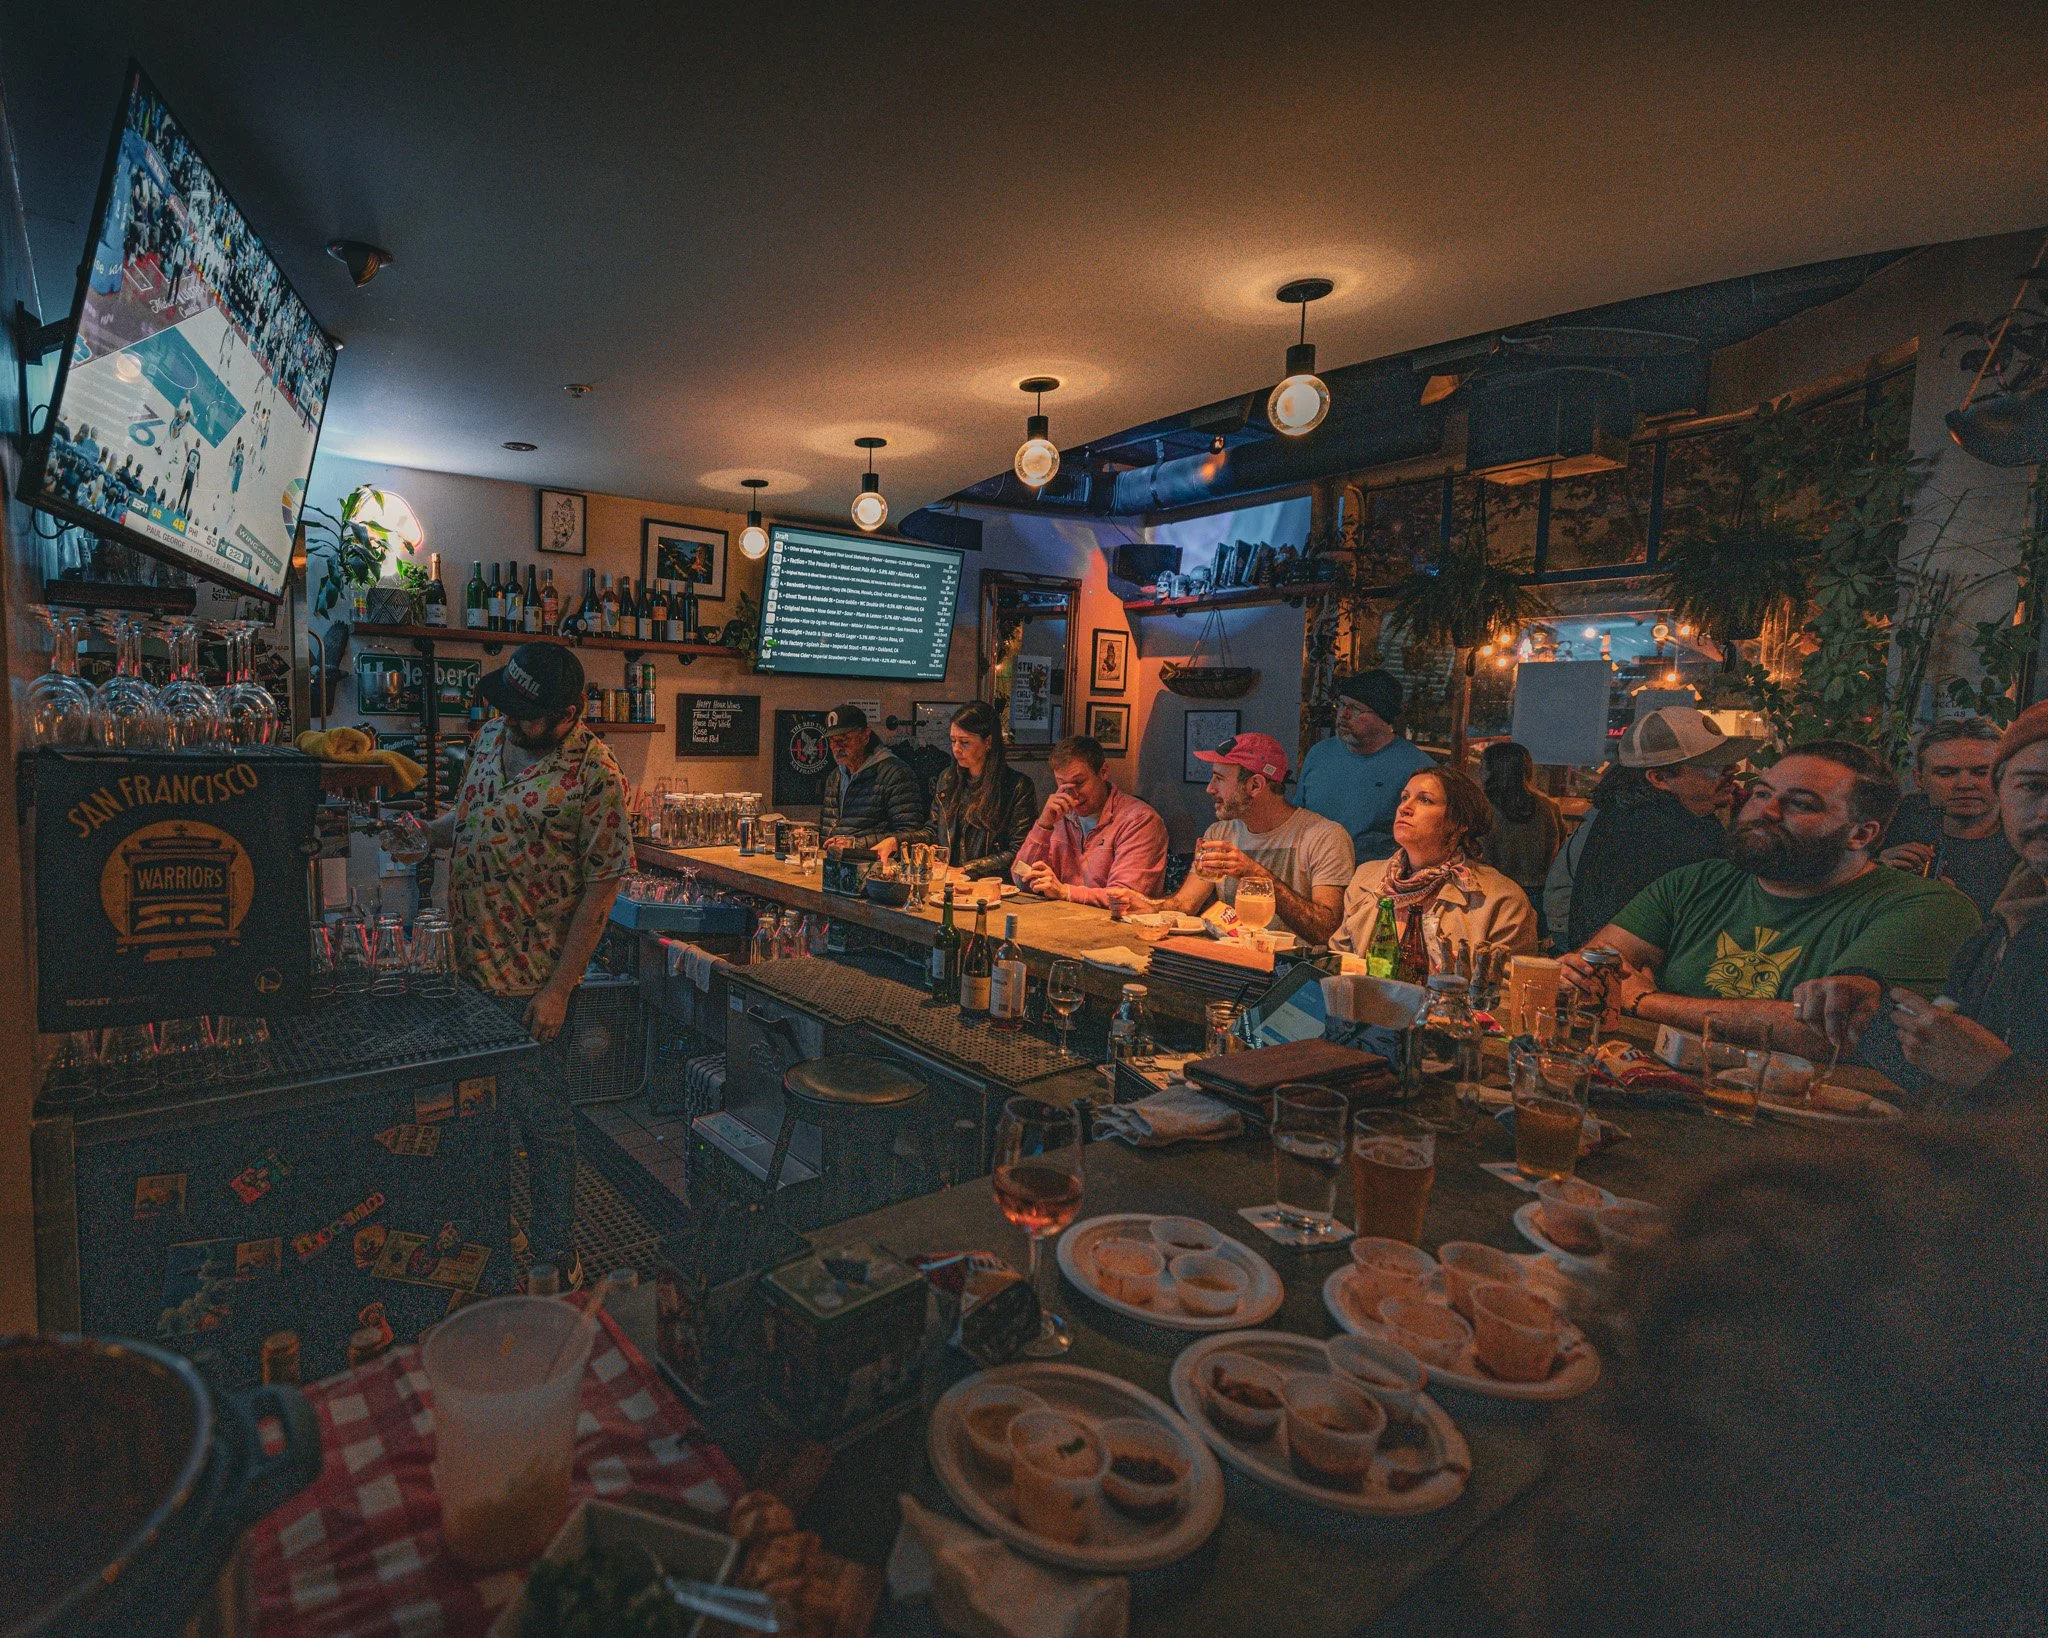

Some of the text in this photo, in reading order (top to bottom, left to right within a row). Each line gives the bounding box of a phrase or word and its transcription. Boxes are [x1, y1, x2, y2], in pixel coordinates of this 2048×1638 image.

[131, 497, 149, 514] ESPN
[172, 518, 186, 532] 48
[188, 526, 199, 537] PHI
[206, 535, 217, 548] 55
[146, 525, 161, 538] PAUL
[162, 532, 185, 549] GEORGE
[775, 532, 789, 540] Draft
[791, 723, 802, 734] THE
[67, 763, 259, 839] SAN FRANCISCO
[136, 867, 223, 891] WARRIORS
